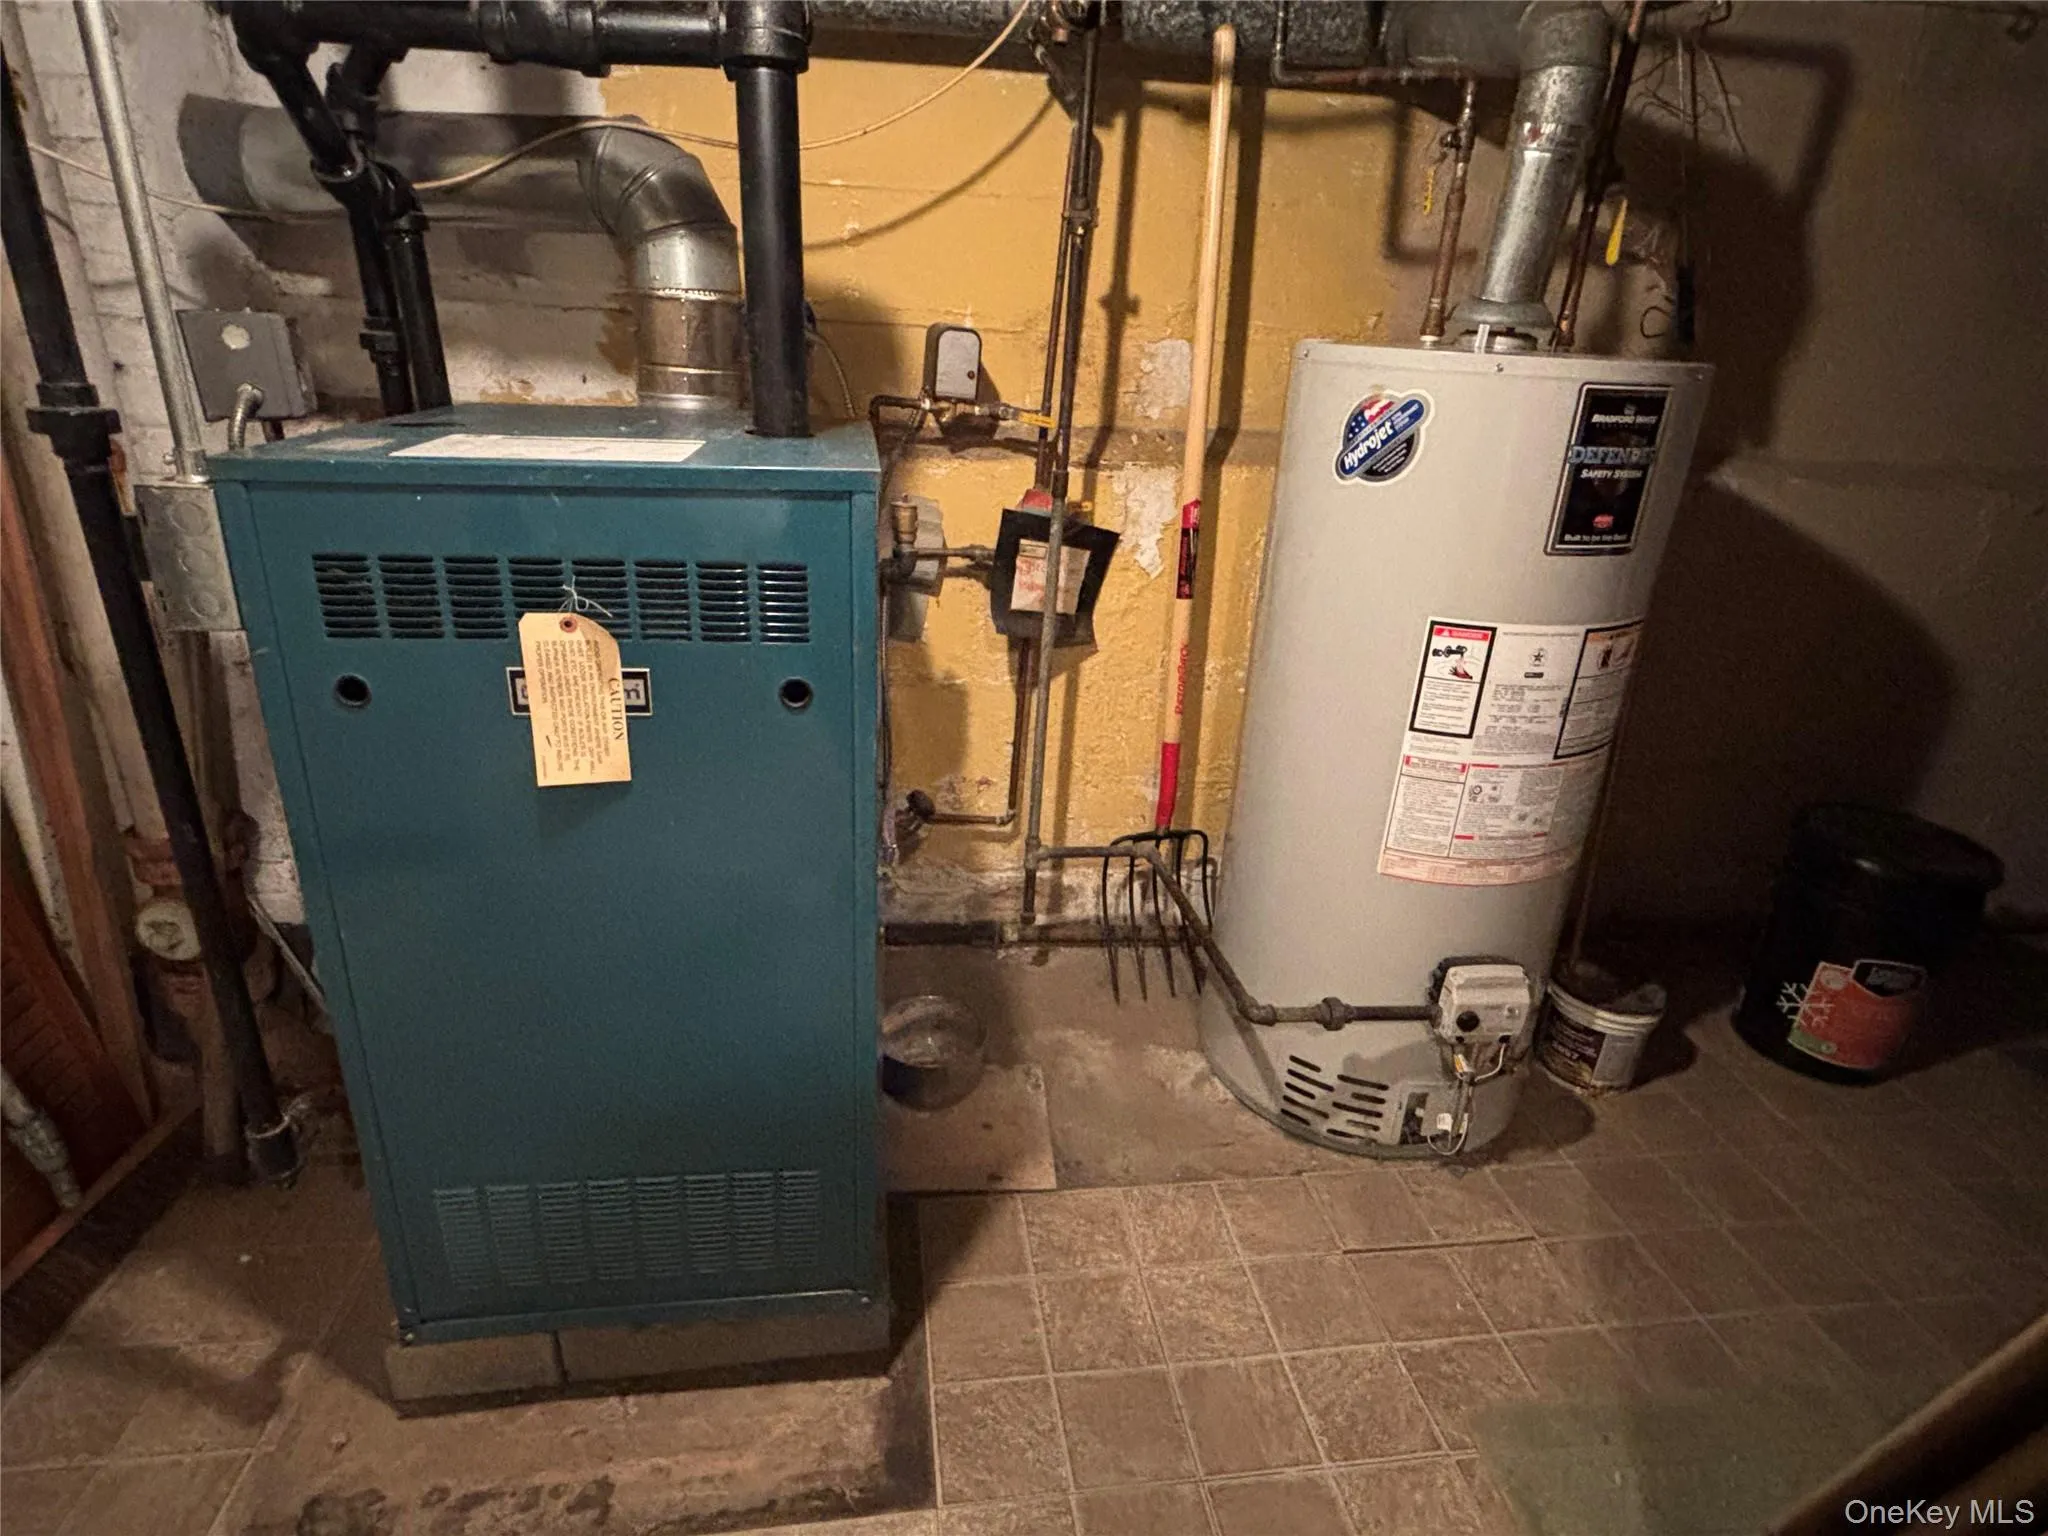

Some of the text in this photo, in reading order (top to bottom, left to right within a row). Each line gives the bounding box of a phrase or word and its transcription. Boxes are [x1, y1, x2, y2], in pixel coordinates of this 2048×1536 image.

[1591, 414, 1635, 424] BRADFORD
[1343, 420, 1394, 470] Hydrojet
[1580, 469, 1613, 479] SAFETY
[607, 677, 626, 740] CAUTION
